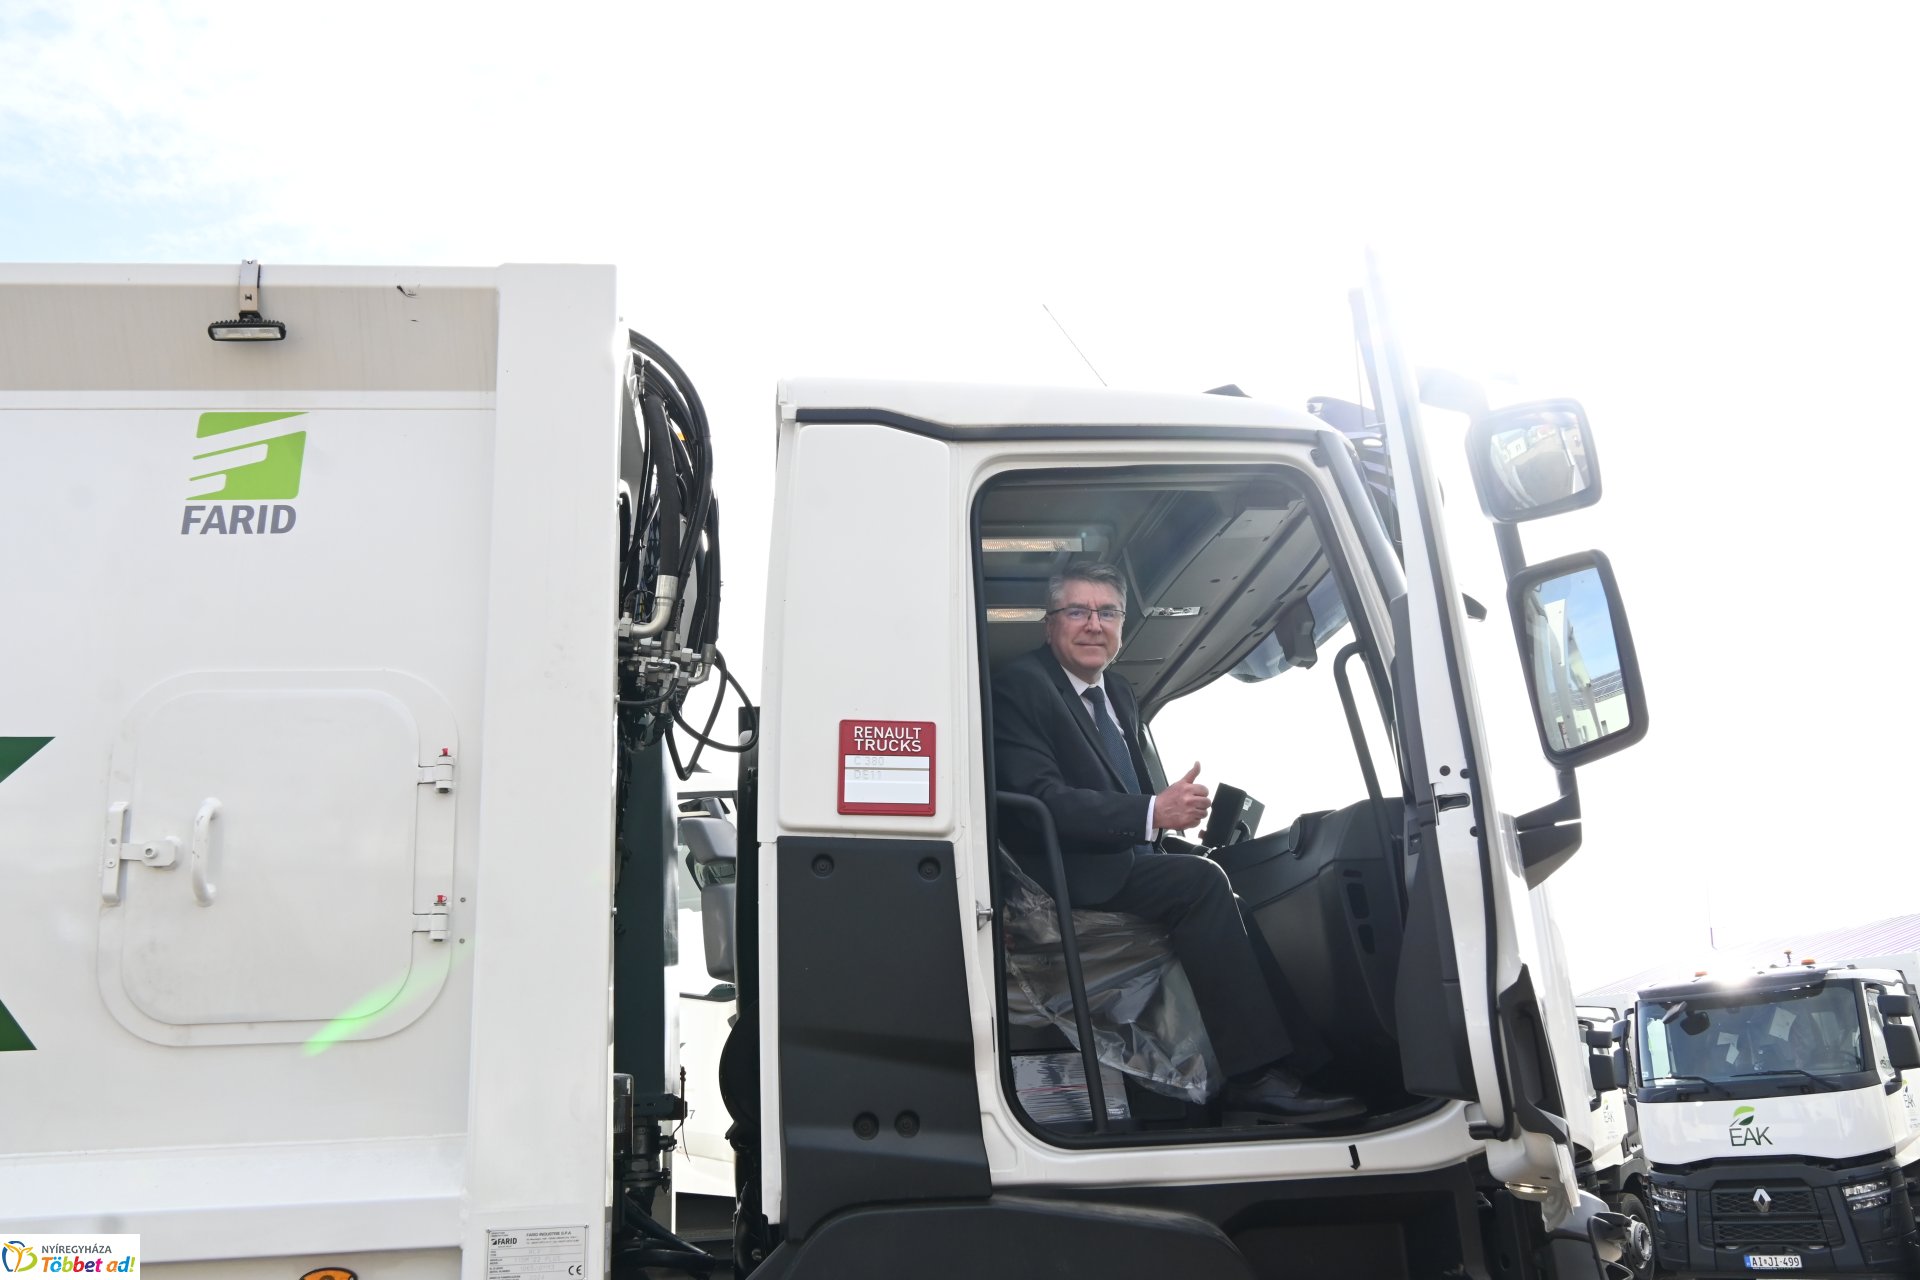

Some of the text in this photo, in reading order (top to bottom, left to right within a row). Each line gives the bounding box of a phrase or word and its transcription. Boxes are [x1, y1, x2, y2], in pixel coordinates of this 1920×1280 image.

[181, 505, 297, 535] FARID
[854, 726, 922, 739] RENAULT
[854, 739, 922, 752] TRUCKS
[497, 1237, 518, 1245] FARID
